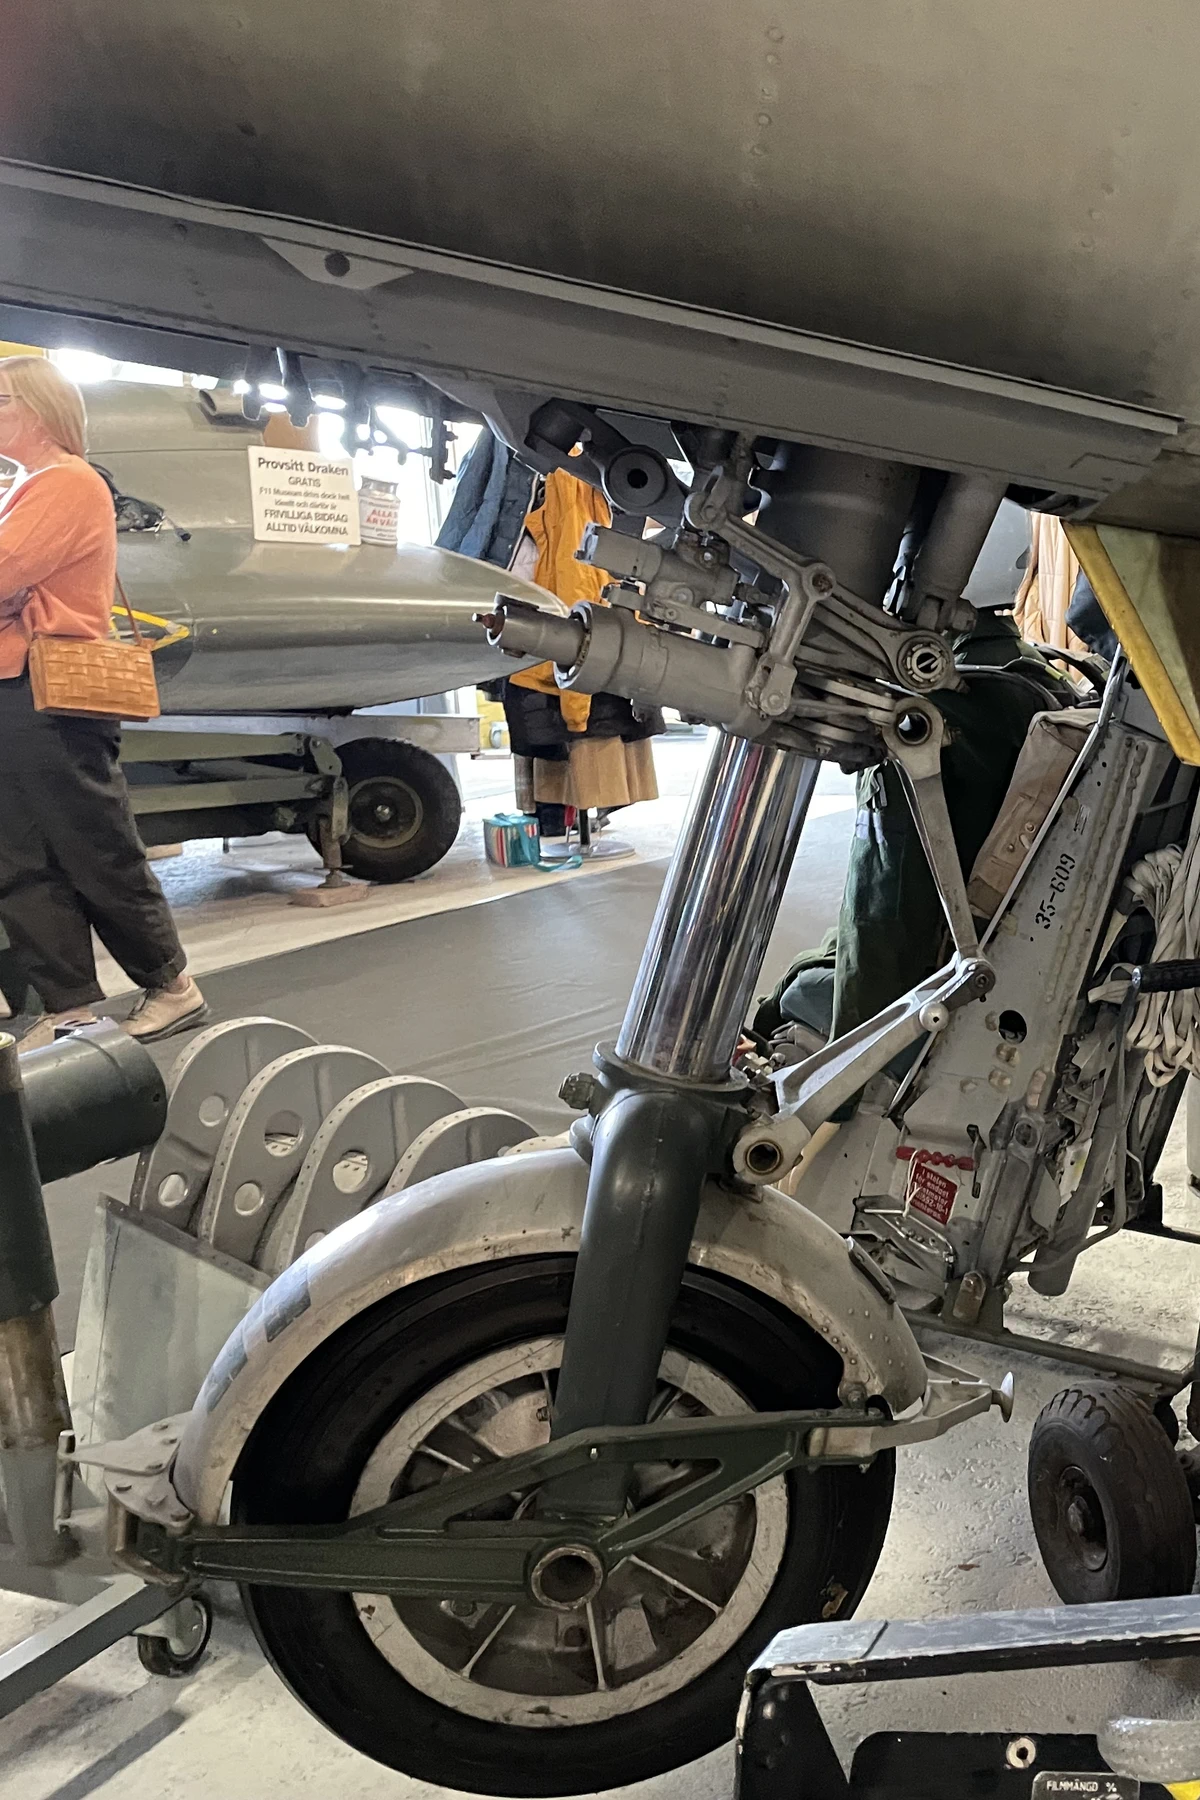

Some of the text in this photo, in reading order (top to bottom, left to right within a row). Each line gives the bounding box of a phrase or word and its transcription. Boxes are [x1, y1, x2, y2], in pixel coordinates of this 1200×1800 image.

[258, 457, 349, 476] Provsitt Draken
[288, 476, 321, 488] GRATIS
[264, 508, 349, 523] FRIVILLIGA BIDRAG
[266, 522, 297, 533] ALLTID
[298, 522, 349, 536] VÄLKOMNA
[1035, 853, 1076, 929] 35-609
[1105, 1782, 1118, 1792] %
